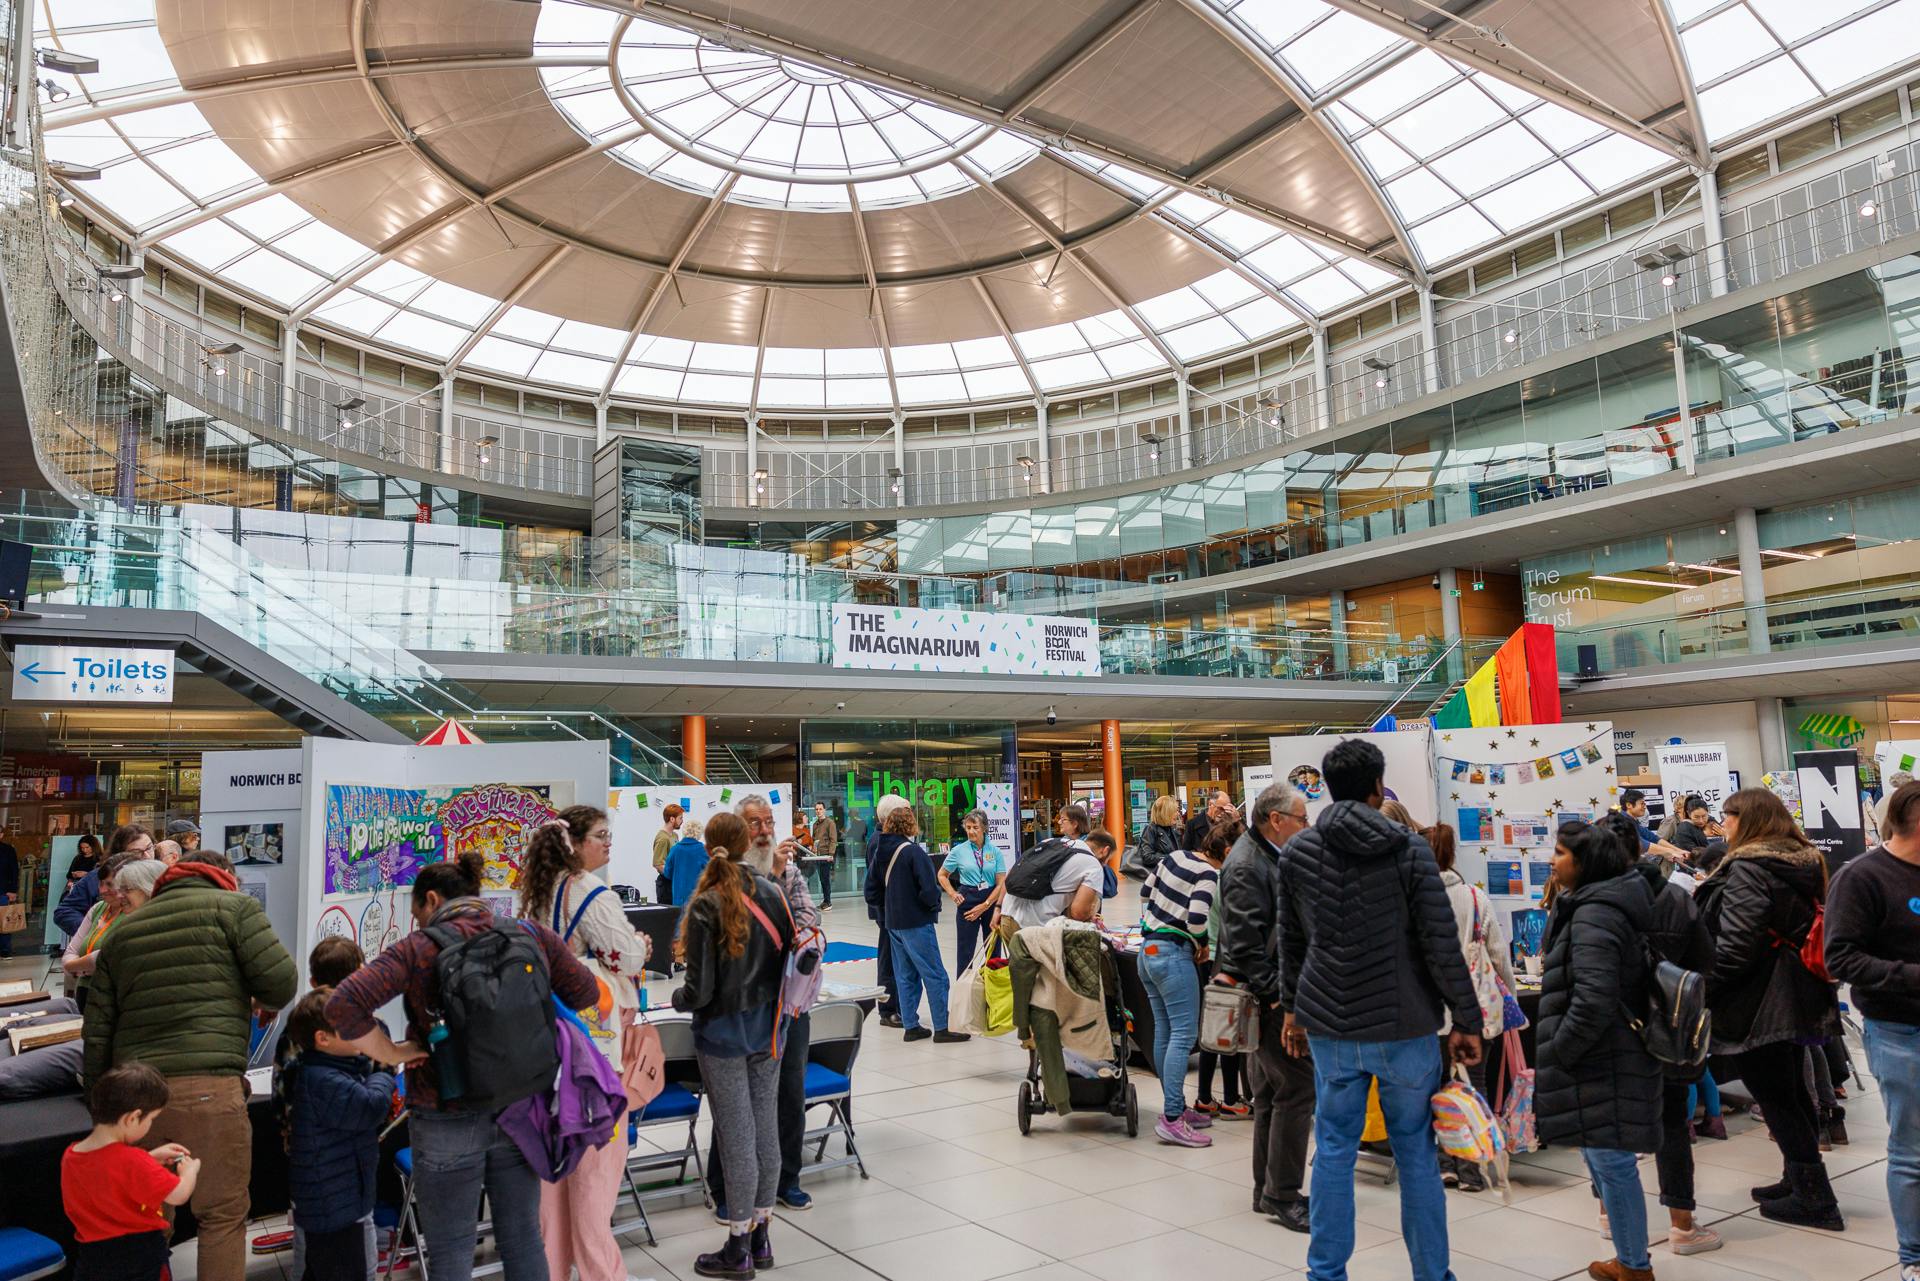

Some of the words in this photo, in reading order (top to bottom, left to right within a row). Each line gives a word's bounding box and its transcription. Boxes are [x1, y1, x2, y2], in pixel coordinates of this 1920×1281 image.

[1525, 569, 1560, 587] The
[1528, 586, 1592, 610] Forum
[847, 612, 886, 633] THE
[1044, 624, 1088, 638] NORWICH
[848, 633, 981, 658] IMAGINARIUM
[1045, 637, 1071, 649] BOOK
[1045, 649, 1087, 662] FESTIVAL
[72, 657, 167, 680] Toilets
[1839, 728, 1866, 749] CITY
[1669, 753, 1692, 763] HUMAN
[1694, 752, 1722, 763] LIBRARY
[16, 766, 61, 777] American
[230, 774, 285, 787] NORWICH
[846, 771, 982, 813] Library
